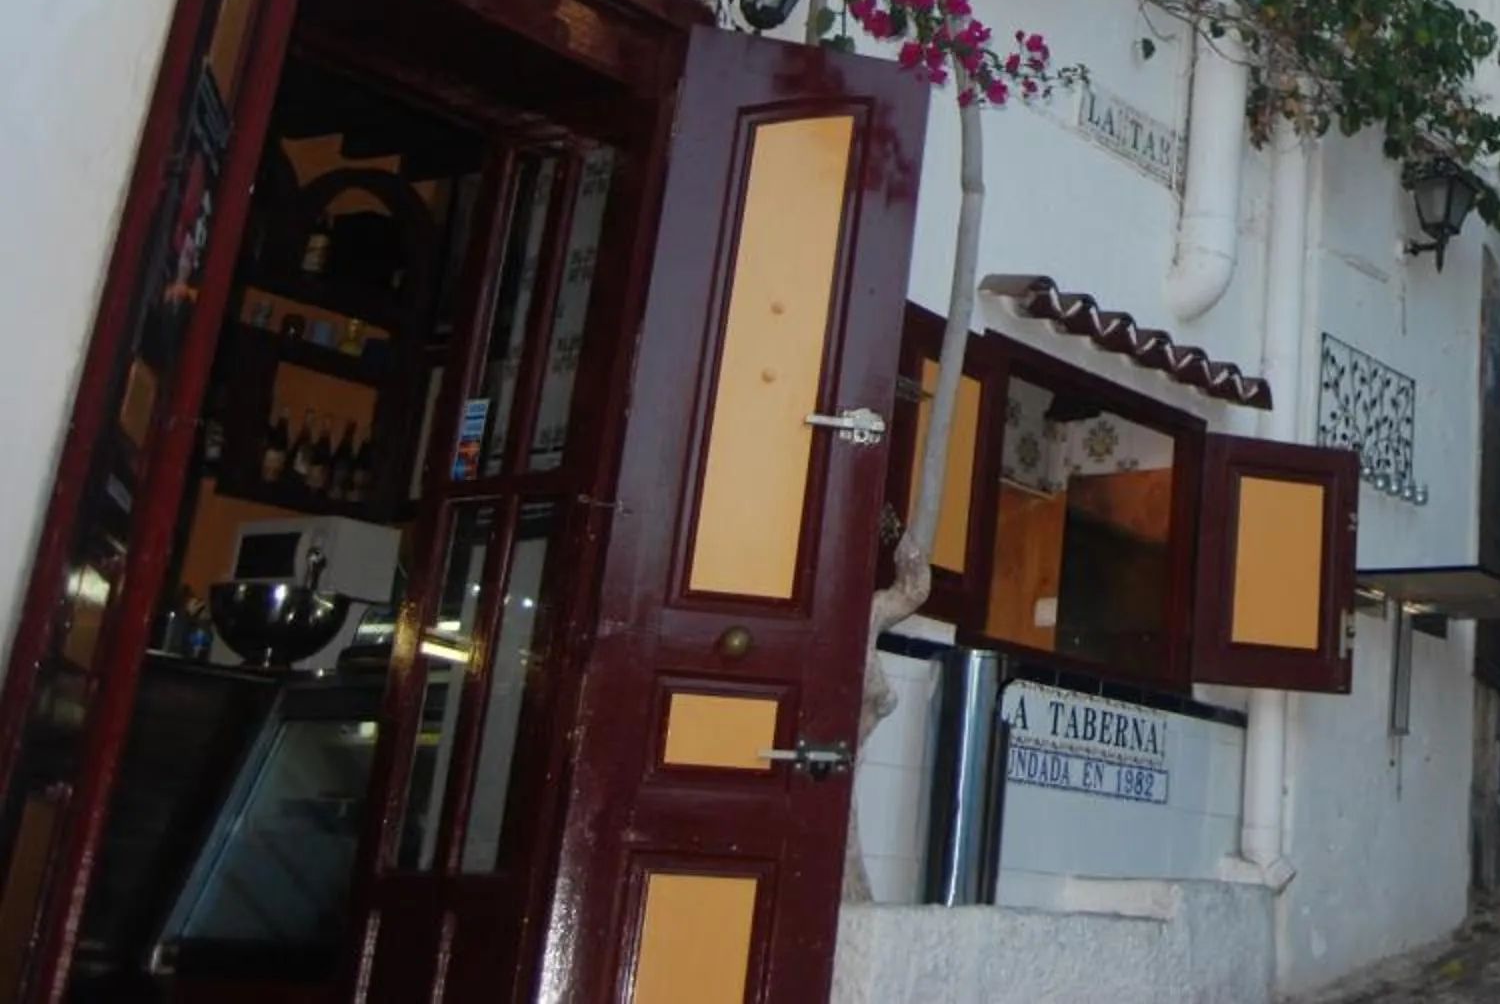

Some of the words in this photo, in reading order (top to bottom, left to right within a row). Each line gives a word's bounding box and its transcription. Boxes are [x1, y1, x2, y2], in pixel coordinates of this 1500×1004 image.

[1007, 694, 1029, 731] A
[1049, 700, 1159, 756] TABERNA
[1007, 748, 1071, 786] UNDADA
[1082, 761, 1105, 789] EN
[1117, 769, 1155, 797] 1982
